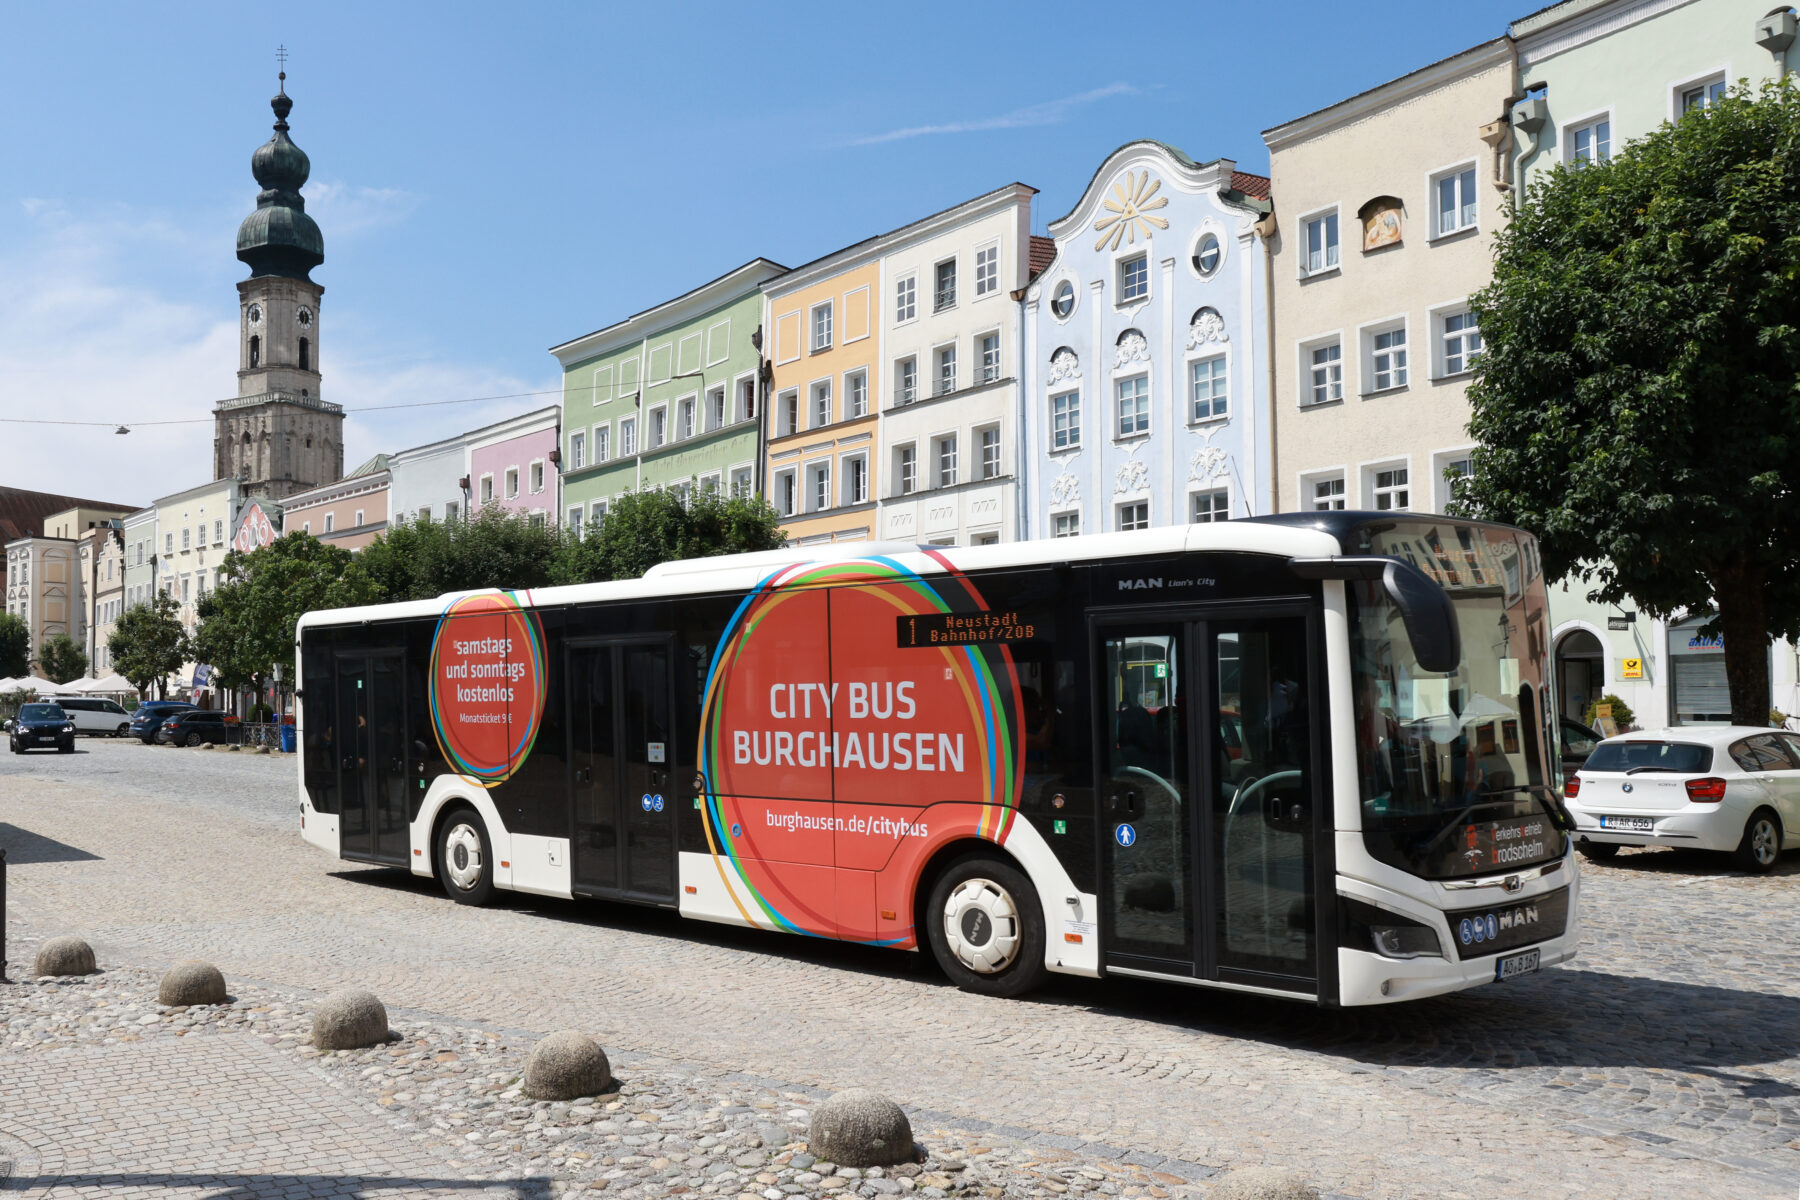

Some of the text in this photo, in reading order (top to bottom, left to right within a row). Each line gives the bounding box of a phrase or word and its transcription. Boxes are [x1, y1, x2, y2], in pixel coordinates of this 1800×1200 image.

[1118, 578, 1216, 590] MAN Lion's City
[909, 613, 1018, 645] 1 Neustadt
[930, 625, 1035, 642] Bahnhof/ZOB
[457, 637, 513, 658] samstags
[446, 660, 526, 682] und sonntags
[457, 683, 514, 702] kostenlos
[770, 681, 916, 720] CITY BUS
[459, 713, 501, 724] Monatsticket
[733, 730, 964, 772] BURGHAUSEN
[766, 809, 928, 840] burghausen.de/citybus
[1632, 819, 1649, 828] 656
[1491, 840, 1544, 865] brodschelm
[970, 912, 983, 942] MAN
[1499, 905, 1539, 930] MAN
